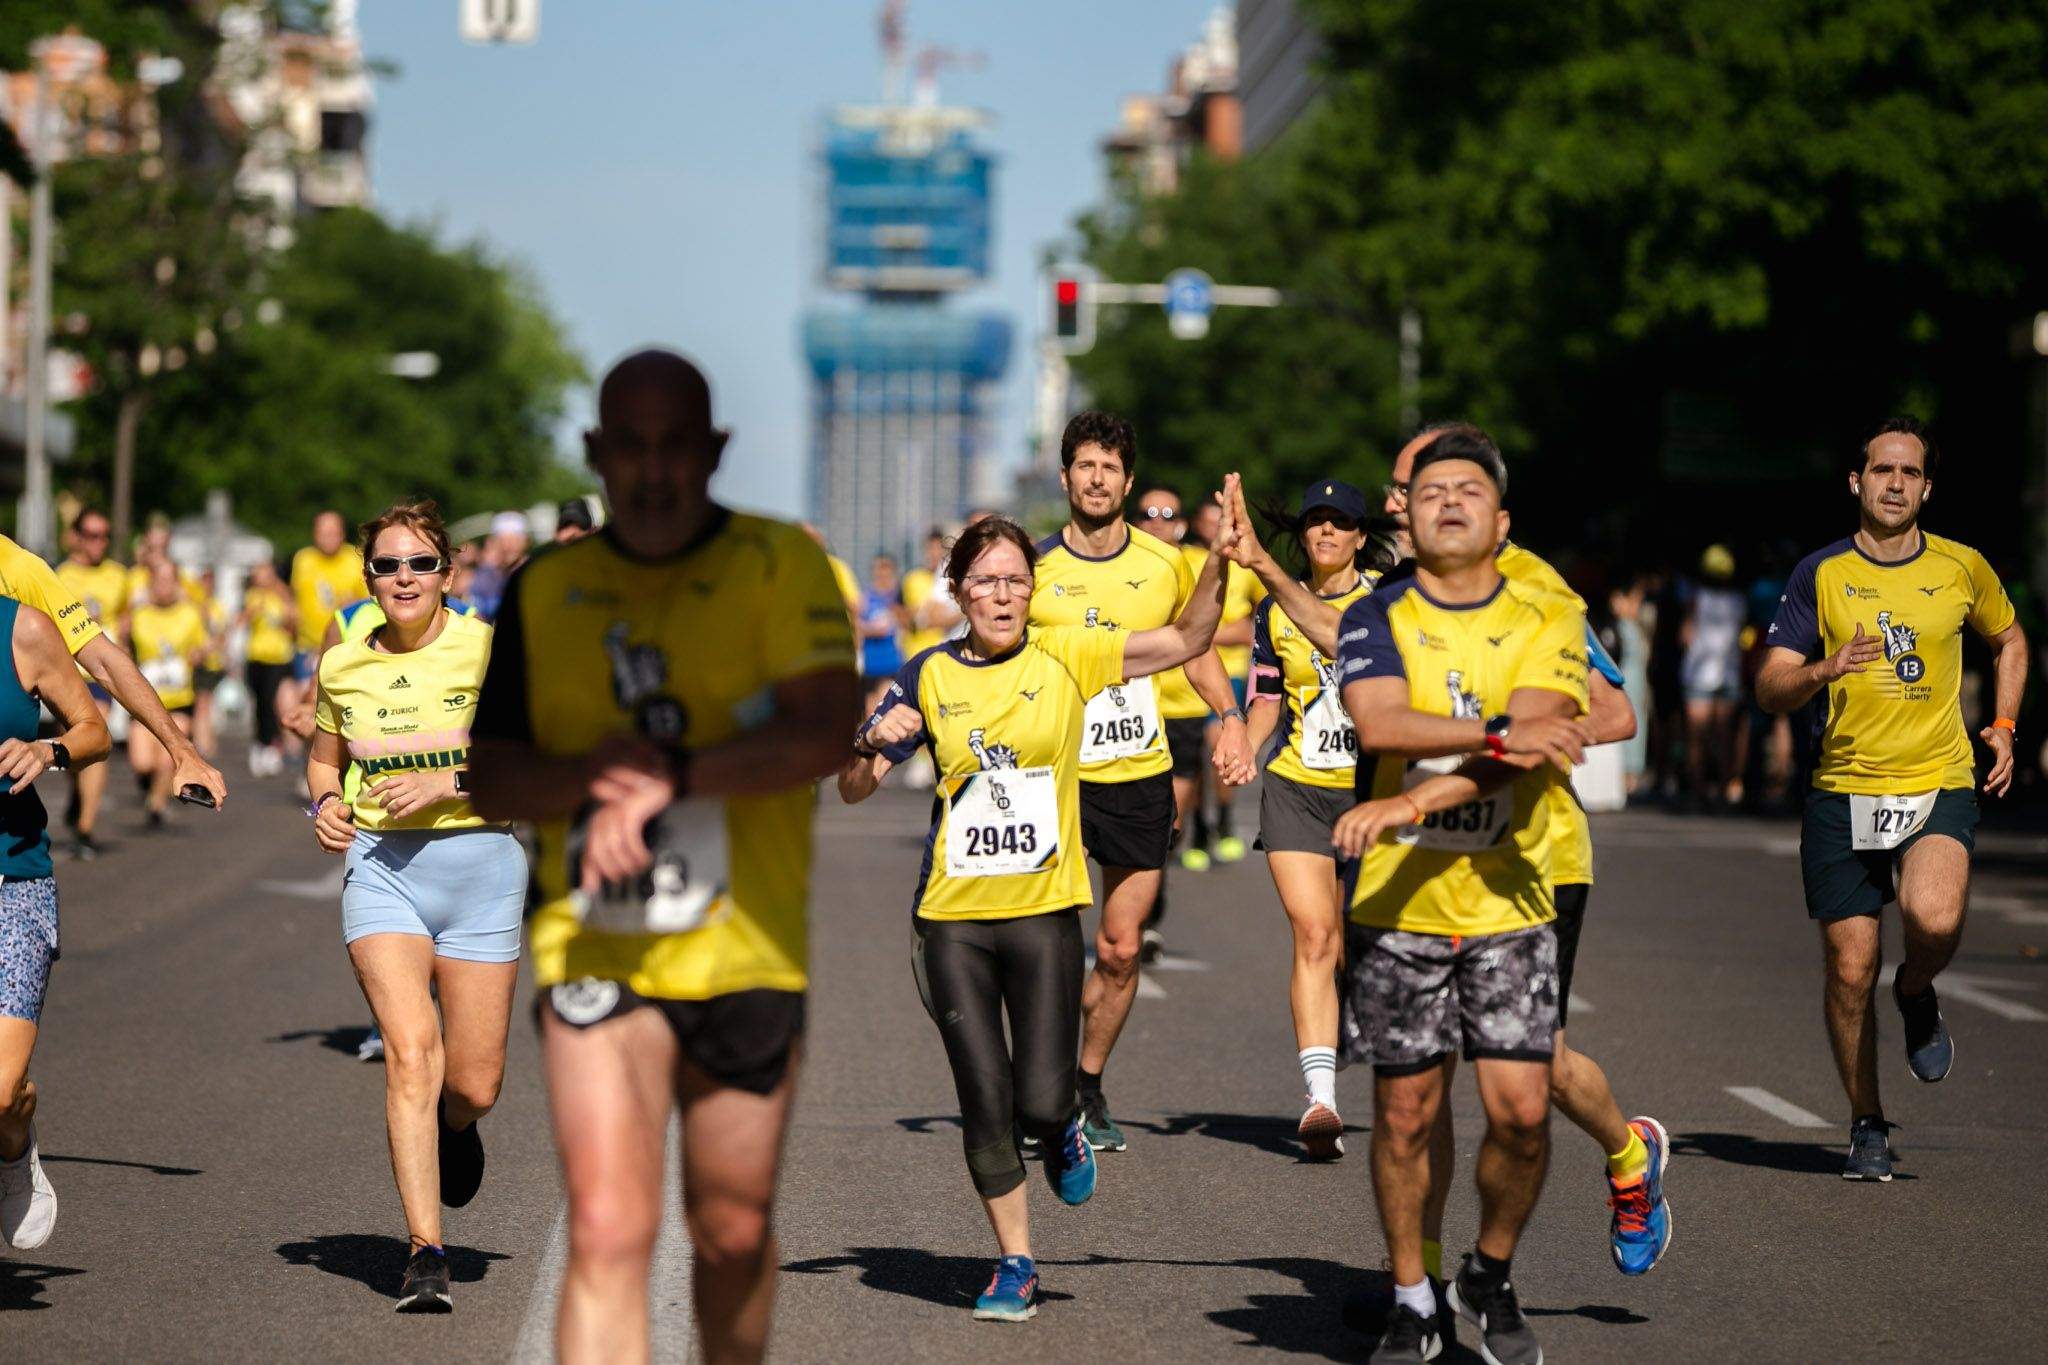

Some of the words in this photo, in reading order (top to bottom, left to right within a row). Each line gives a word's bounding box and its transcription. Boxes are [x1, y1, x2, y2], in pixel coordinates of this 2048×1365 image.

[1901, 661, 1919, 676] 13
[1904, 693, 1930, 701] Liberty
[391, 706, 419, 715] ZURICH
[1091, 715, 1145, 746] 2463
[1872, 807, 1917, 833] 1273
[966, 823, 1037, 856] 2943
